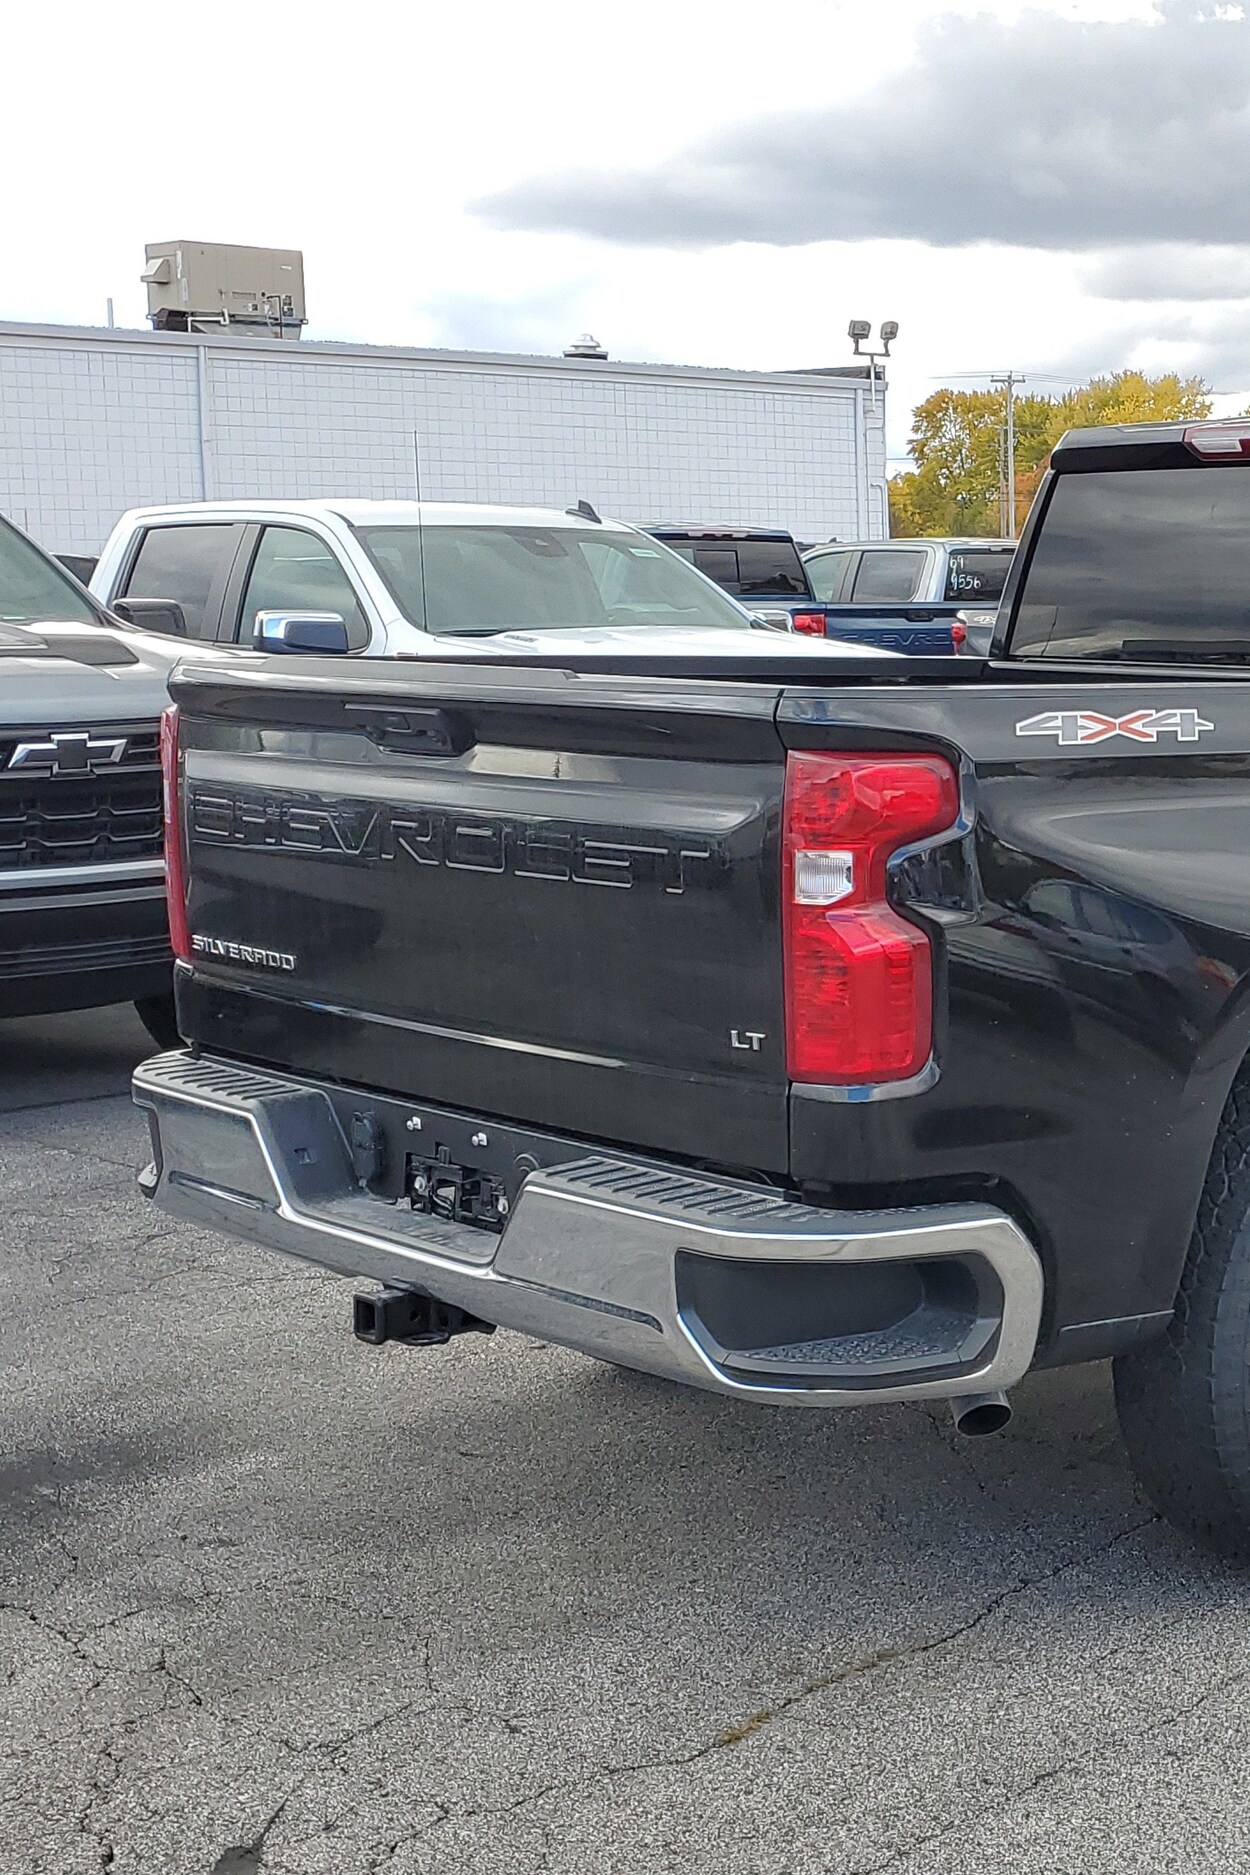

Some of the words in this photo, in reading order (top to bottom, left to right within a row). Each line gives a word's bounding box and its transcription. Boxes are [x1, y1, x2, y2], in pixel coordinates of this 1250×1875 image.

[843, 632, 952, 646] CHEVRO
[193, 790, 711, 894] CHEVROLET
[192, 934, 295, 970] SILVERADO
[730, 1030, 766, 1050] LT
